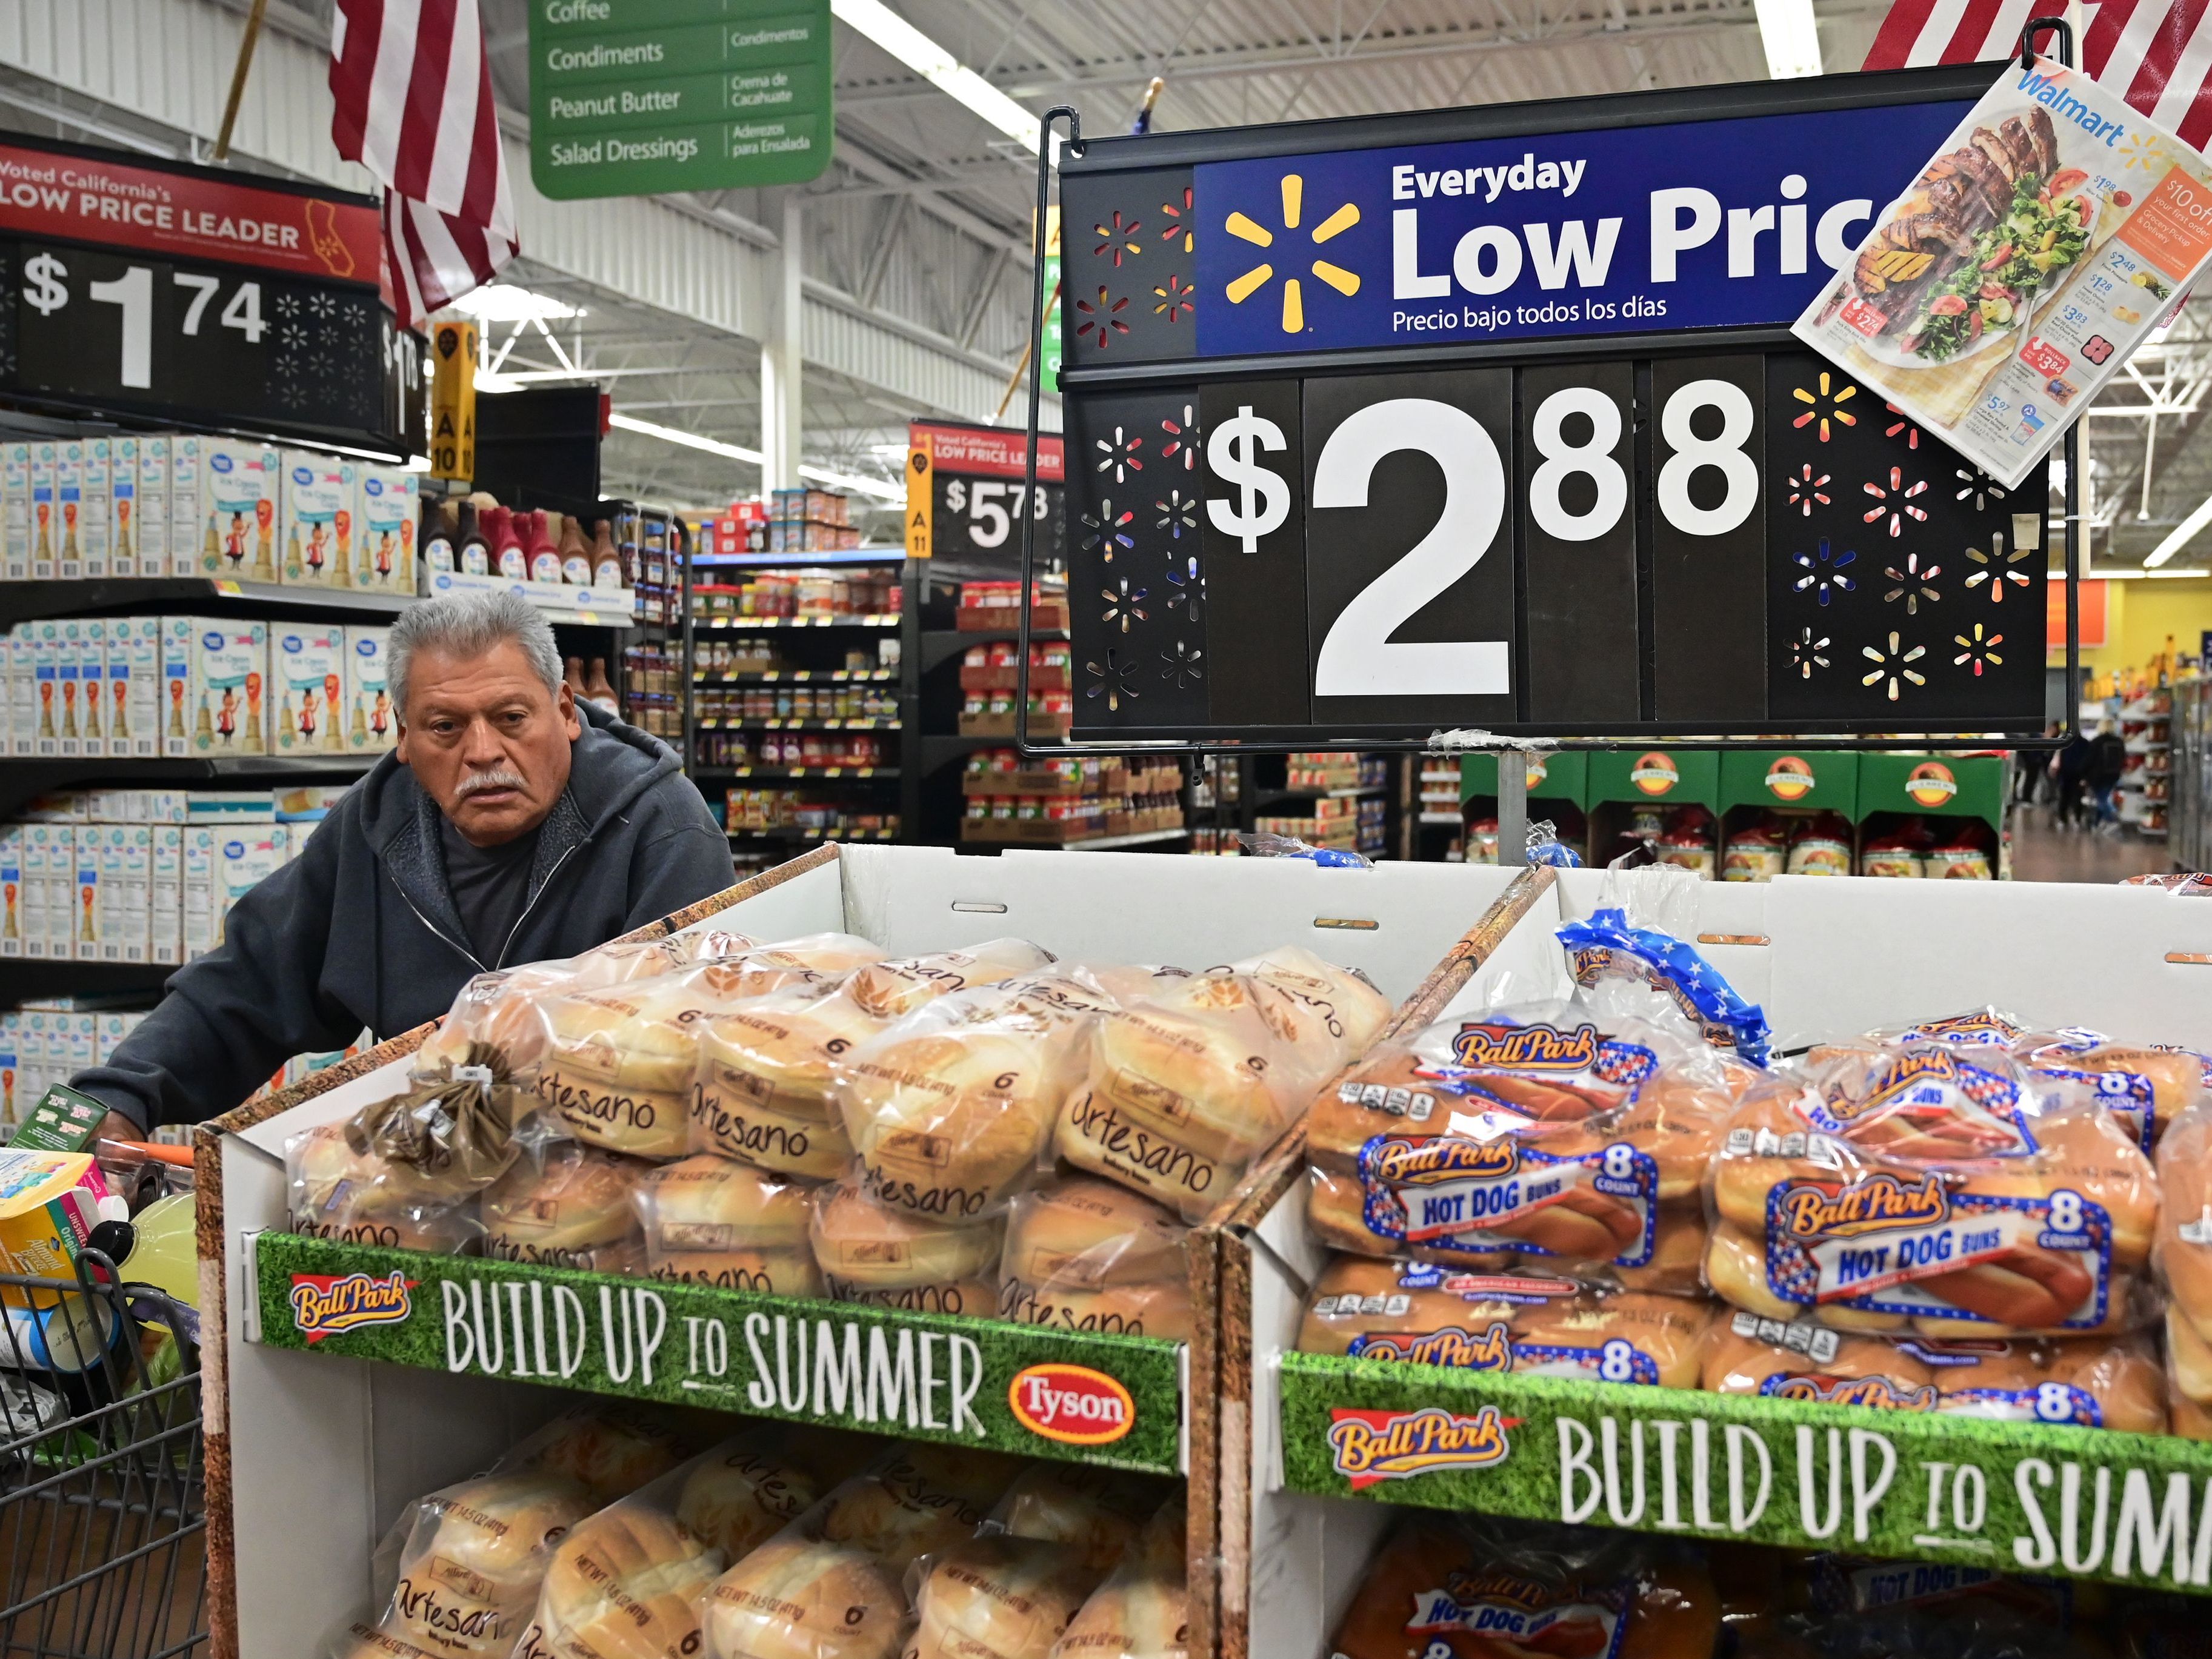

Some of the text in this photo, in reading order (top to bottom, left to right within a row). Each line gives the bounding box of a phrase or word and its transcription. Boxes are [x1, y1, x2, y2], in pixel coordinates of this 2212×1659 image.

[546, 0, 610, 23] Coffee
[731, 28, 808, 48] Condimentos
[548, 42, 664, 71] Condiments
[732, 73, 788, 91] Crema de
[550, 91, 681, 120] Peanut Butter
[732, 90, 792, 107] Cacahuate
[2015, 69, 2128, 147] Walmart
[733, 123, 784, 139] Aderezos
[551, 136, 698, 167] Salad Dressings
[733, 136, 810, 159] para Ensalada
[0, 160, 172, 203] Voted California's
[1392, 152, 1587, 202] Everyday
[2168, 180, 2193, 207] $10
[0, 179, 69, 213] LOW
[79, 193, 173, 230] PRICE
[183, 208, 300, 250] LEADER
[2154, 196, 2210, 239] your first order.
[1392, 174, 1899, 300] Low Pric
[2143, 221, 2169, 244] Delivery
[2144, 210, 2190, 247] Grocery Pickup
[2110, 251, 2136, 272] $248
[2090, 274, 2112, 291] $128
[1392, 294, 1667, 333] Precio bajo todos los días
[1857, 313, 1878, 329] $274
[2063, 305, 2087, 324] $383
[2037, 353, 2063, 373] $384
[1986, 392, 2010, 413] $597
[436, 413, 455, 439] A
[434, 448, 456, 471] 10
[934, 445, 1060, 468] LOW PRICE LEDER
[912, 511, 926, 528] A
[914, 536, 926, 551] 11
[678, 1009, 702, 1024] 6
[826, 1038, 852, 1054] 6
[1457, 1026, 1594, 1066] Ball Park
[1248, 1056, 1268, 1071] 6
[994, 1072, 1019, 1089] 6
[1447, 1139, 1513, 1169] Park
[1604, 1144, 1634, 1179] 8
[1596, 1179, 1639, 1194] COUNT
[1423, 1194, 1464, 1225] HOT
[1472, 1180, 1519, 1214] DOG
[1527, 1179, 1561, 1202] BUNS
[1788, 1178, 1944, 1238] Ball Park
[2050, 1191, 2084, 1234] 8
[2040, 1232, 2091, 1249] COUNT
[27, 1239, 65, 1271] Almond
[1837, 1226, 2002, 1285] HOT DOG BUNS
[1399, 1275, 1440, 1287] COUNT
[295, 1274, 407, 1328] Ball Park
[442, 1279, 987, 1437] BUILD UP TO SUMMER
[1602, 1341, 1633, 1381] 8
[1024, 1376, 1125, 1425] Tyson
[2037, 1383, 2072, 1420] 8
[1333, 1407, 1503, 1474] Ball Park
[1557, 1417, 1771, 1531] BUILD
[1797, 1423, 1896, 1542] UP
[1921, 1460, 1985, 1533] TO
[1914, 1566, 1956, 1595] DOG
[845, 1605, 867, 1625] 6
[1476, 1607, 1526, 1633] DOG
[681, 1629, 701, 1655] 6
